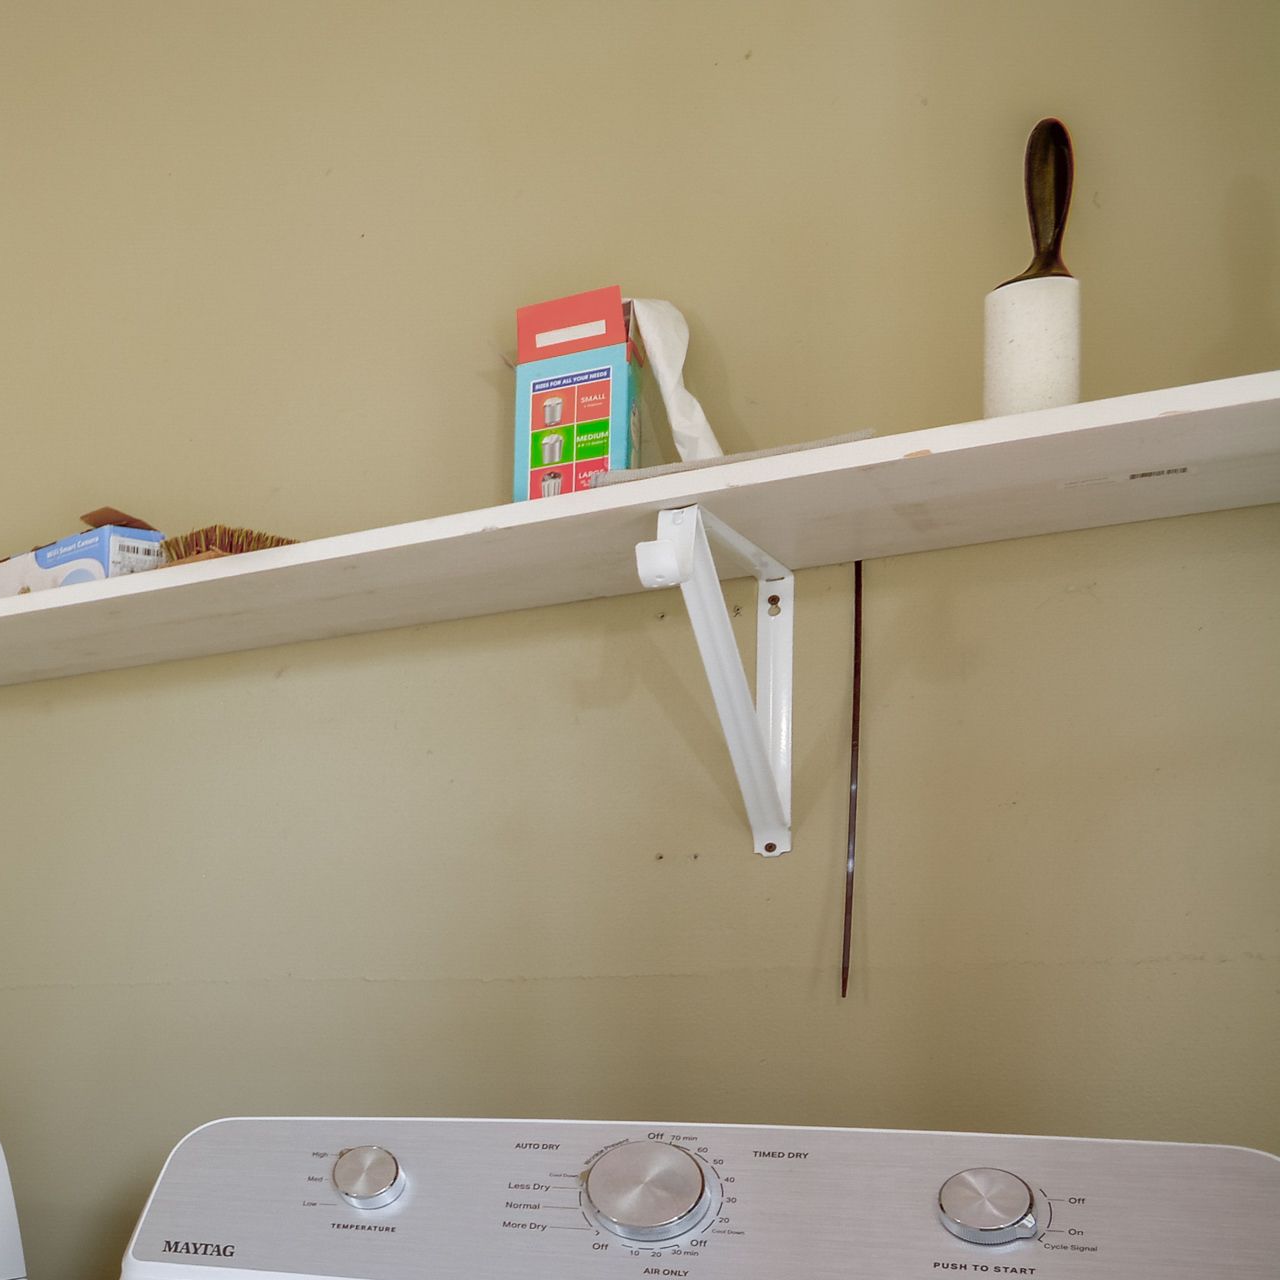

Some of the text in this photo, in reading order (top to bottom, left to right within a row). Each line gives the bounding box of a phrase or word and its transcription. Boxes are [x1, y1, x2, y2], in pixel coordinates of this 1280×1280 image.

[562, 377, 572, 385] ALL
[573, 374, 588, 383] YOUR
[589, 371, 607, 380] NEEDS
[581, 393, 606, 403] SMALL
[576, 431, 609, 442] MEDIUM
[77, 536, 100, 548] Camera
[647, 1132, 665, 1140] Off
[515, 1142, 561, 1151] AUTO DRY
[312, 1151, 329, 1159] High
[752, 1150, 809, 1159] TIMED DRY
[508, 1182, 551, 1192] Less Dry
[505, 1201, 541, 1210] Normal
[1068, 1196, 1086, 1205] Off
[331, 1222, 397, 1233] TEMPERATURE
[502, 1221, 548, 1232] More Dry
[1068, 1228, 1085, 1236] On
[162, 1239, 236, 1258] MAYTAG
[592, 1242, 609, 1251] Off
[690, 1239, 708, 1248] Off
[1043, 1242, 1099, 1253] Cycle Signal
[671, 1248, 682, 1256] 30
[683, 1249, 699, 1257] min
[643, 1266, 690, 1278] AIR ONLY
[933, 1261, 1037, 1275] PUSH TO START
